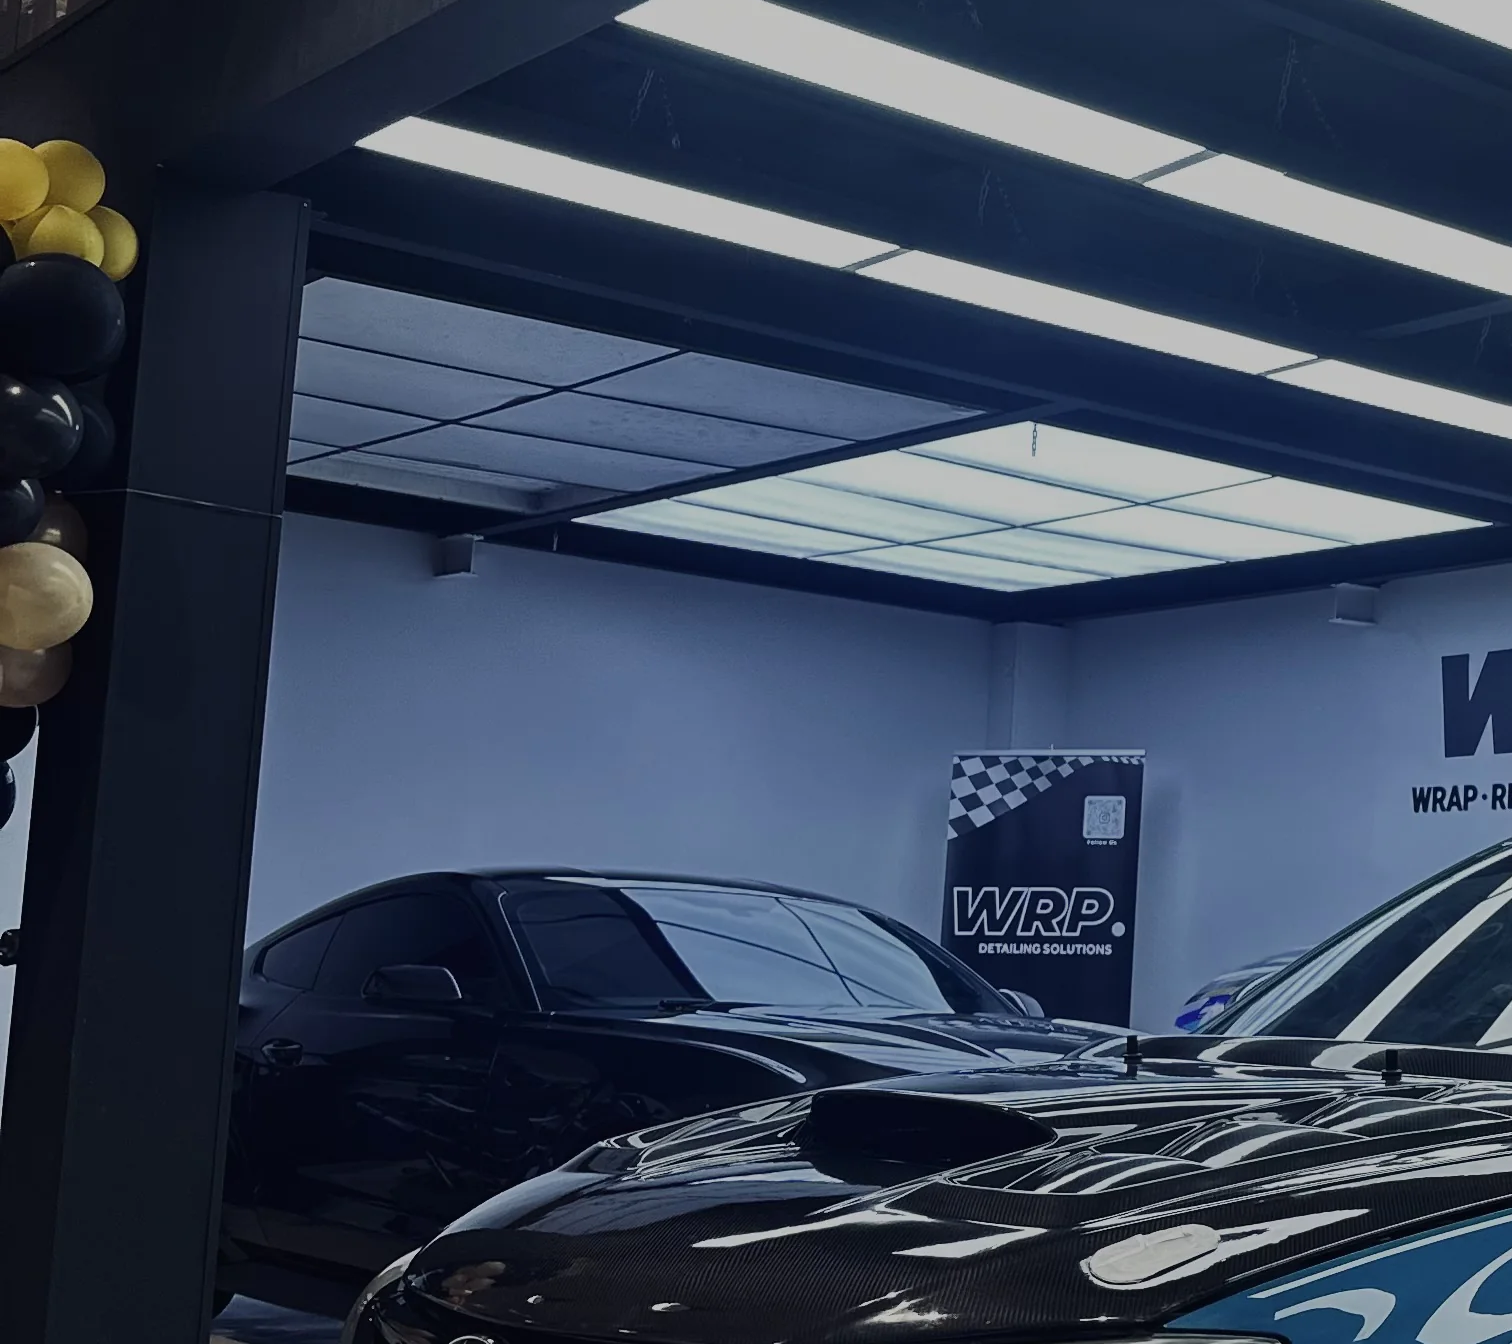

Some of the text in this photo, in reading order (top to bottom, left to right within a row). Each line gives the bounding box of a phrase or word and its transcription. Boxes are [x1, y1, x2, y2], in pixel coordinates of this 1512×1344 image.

[953, 886, 1126, 937] WRP.
[978, 942, 1112, 956] DETAILING SOLUTIONS
